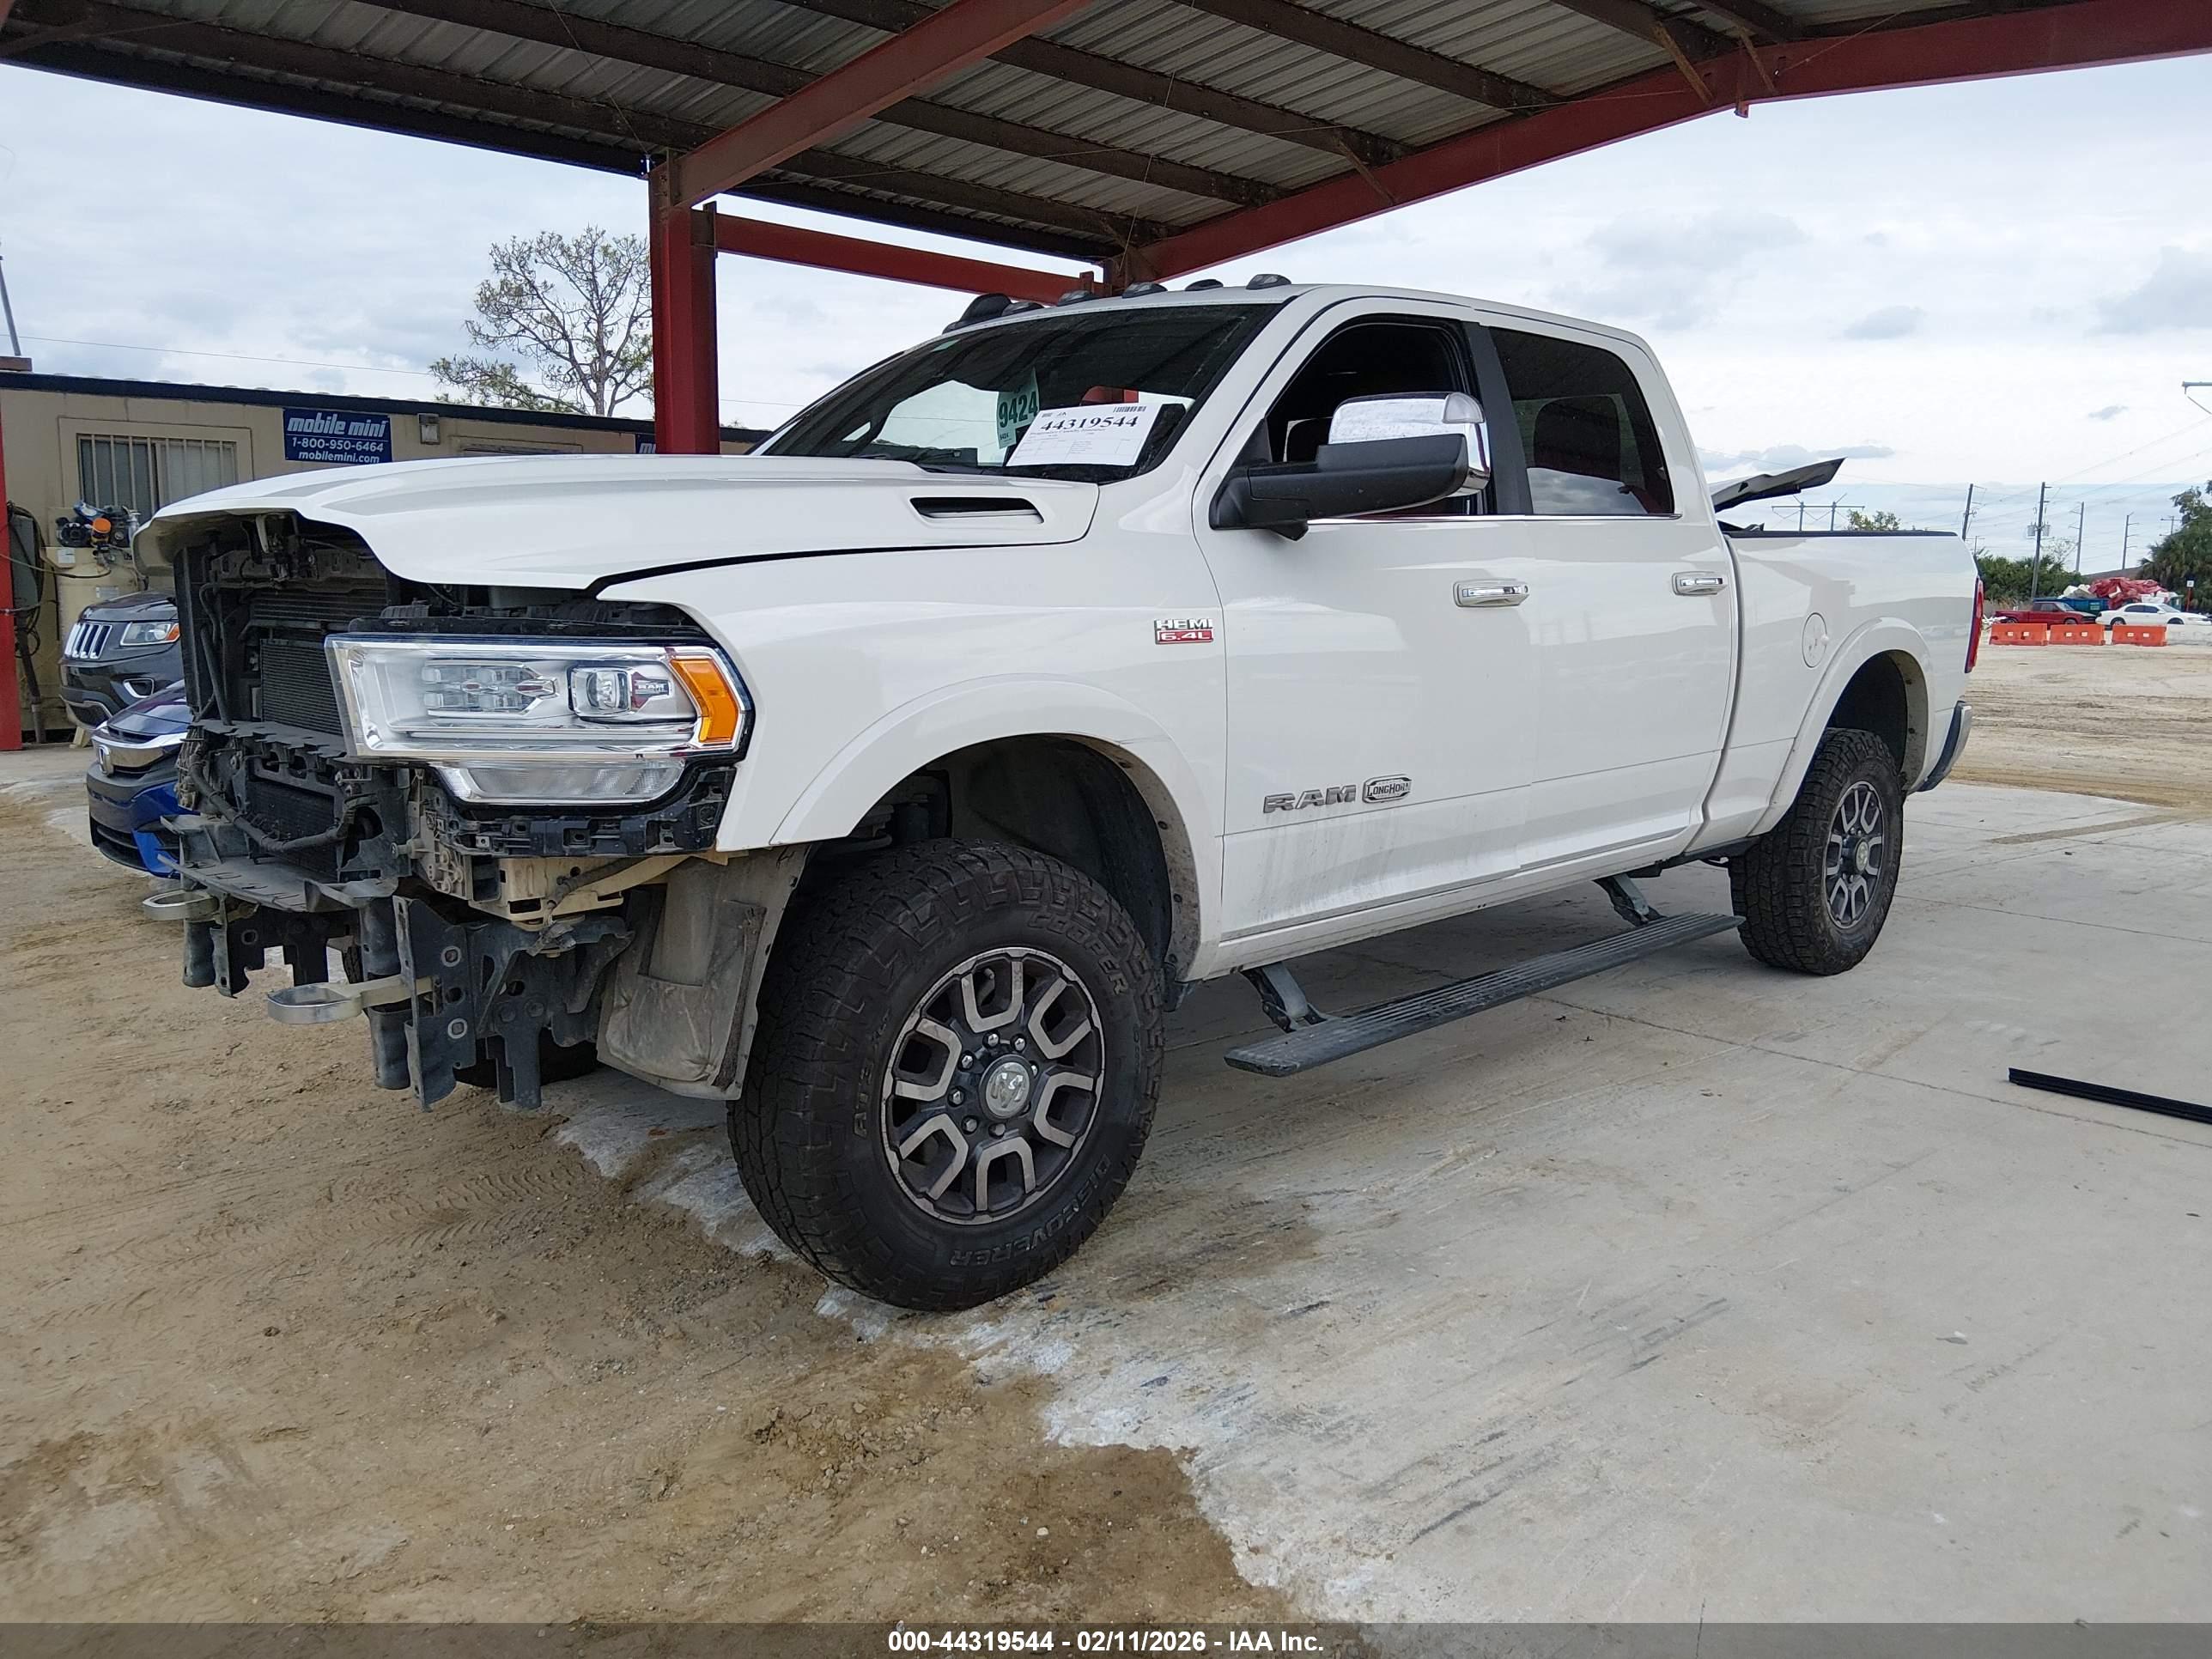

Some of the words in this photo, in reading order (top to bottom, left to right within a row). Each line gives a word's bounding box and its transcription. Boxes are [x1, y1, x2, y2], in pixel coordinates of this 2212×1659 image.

[999, 391, 1038, 428] 9424
[287, 413, 346, 434] mobile
[348, 419, 386, 437] mini
[1040, 416, 1139, 431] 44319544
[292, 437, 383, 452] 1-800-950-6464
[298, 451, 380, 463] mobilemini.com
[1154, 618, 1214, 630] HEMI
[1160, 630, 1211, 641] 6.4L
[1262, 785, 1356, 813] RAM
[1366, 781, 1411, 797] LONGHORN
[1028, 914, 1129, 996] COOPER
[950, 1153, 1112, 1267] DISCOVERER
